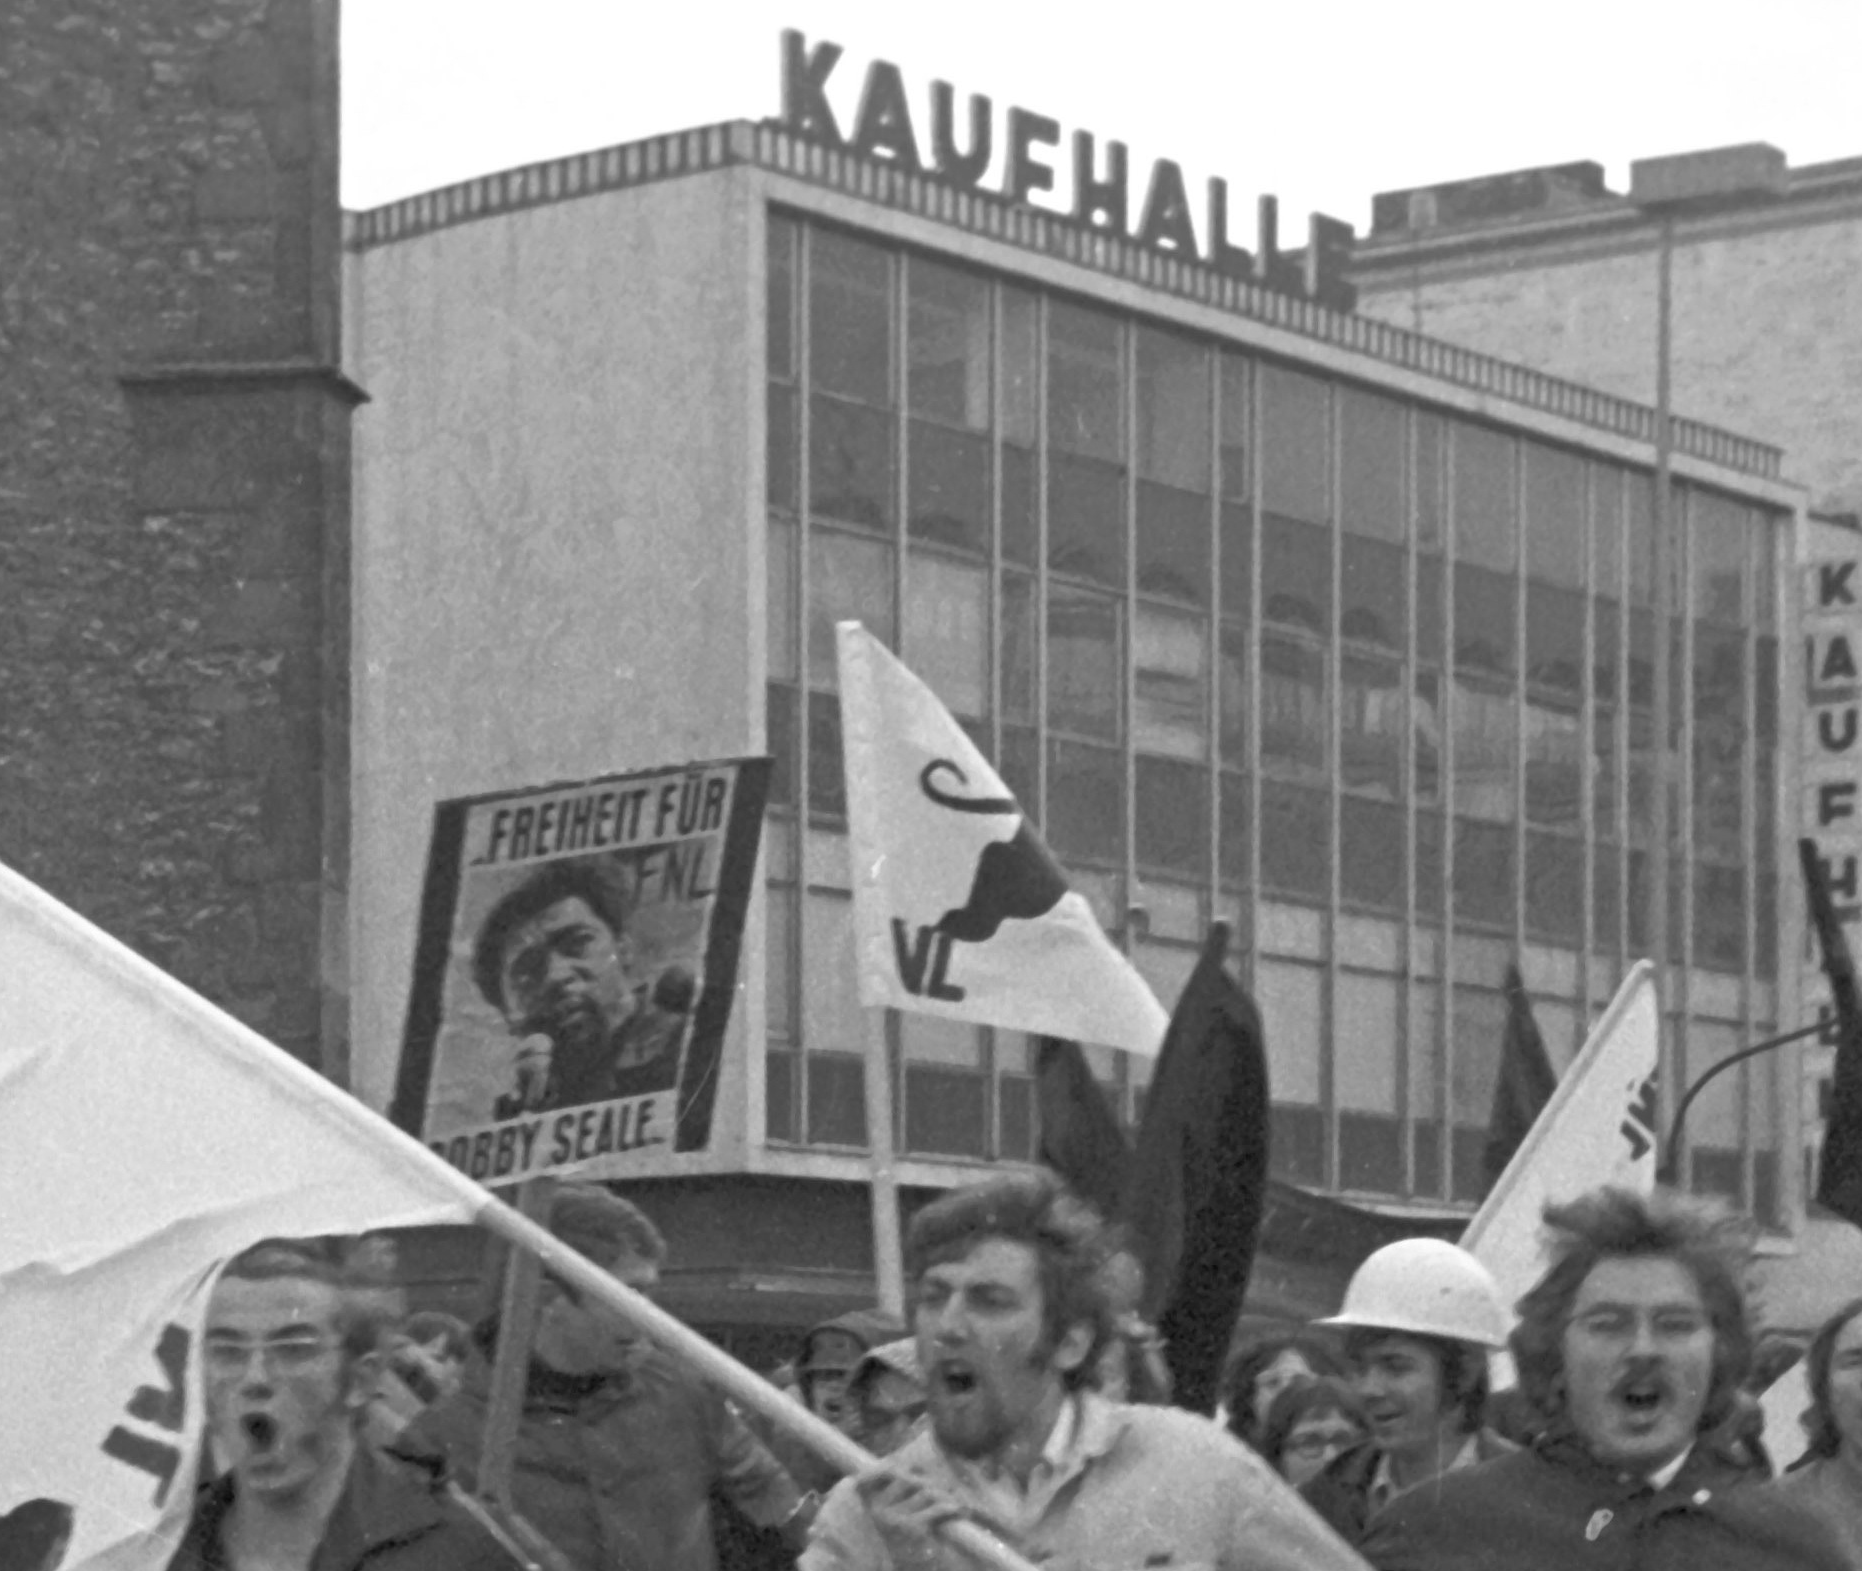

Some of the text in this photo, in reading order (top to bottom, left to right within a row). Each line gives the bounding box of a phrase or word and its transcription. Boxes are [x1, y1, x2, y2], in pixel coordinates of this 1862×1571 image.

[780, 27, 1358, 315] KAUFHALLE
[485, 770, 727, 866] FREIHEIT FÜR
[427, 1098, 657, 1180] OBBY SEALE
